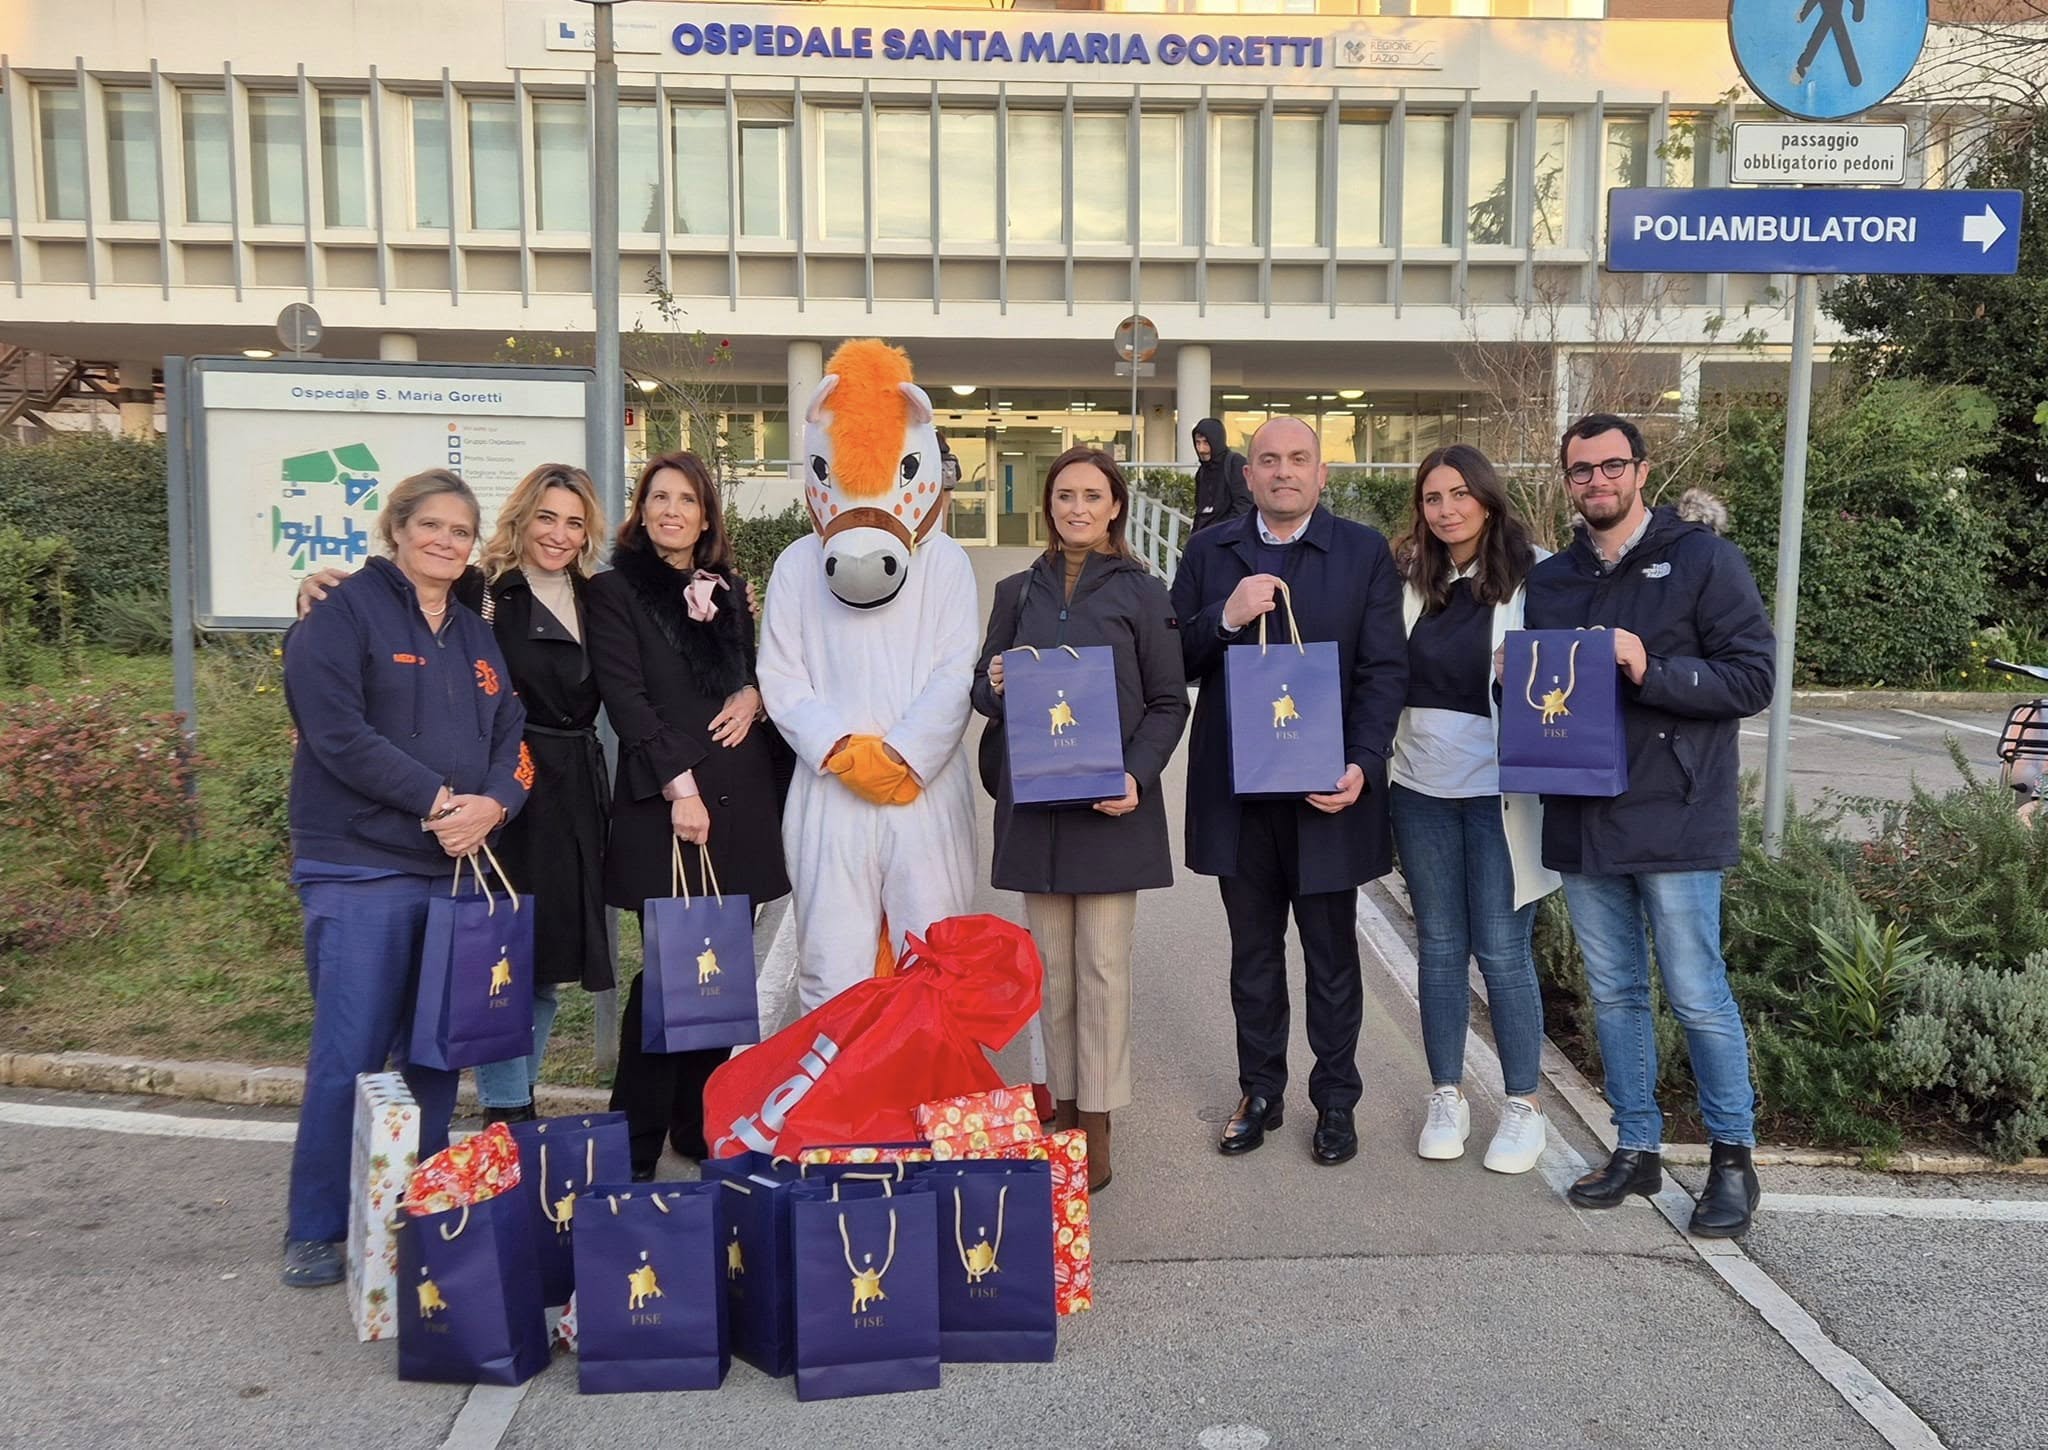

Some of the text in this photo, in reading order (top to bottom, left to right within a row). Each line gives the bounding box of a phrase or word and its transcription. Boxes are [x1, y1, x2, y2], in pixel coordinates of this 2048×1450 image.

[672, 23, 1323, 68] OSPEDALE SANTA MARIA GORETTI
[1370, 41, 1413, 51] REGIONE
[1370, 54, 1400, 63] LAZIO
[1782, 132, 1858, 151] passaggio
[1744, 154, 1894, 174] obbligatorio pedoni
[1634, 215, 1917, 242] POLIAMBULATORI
[291, 387, 502, 403] Ospedale S. Maria Goretti
[1275, 730, 1300, 740] FISE
[1544, 728, 1568, 738] FISE
[1053, 737, 1077, 748] FISE
[970, 1287, 998, 1298] FISE
[632, 1313, 661, 1325] FISE
[854, 1316, 884, 1328] FISE
